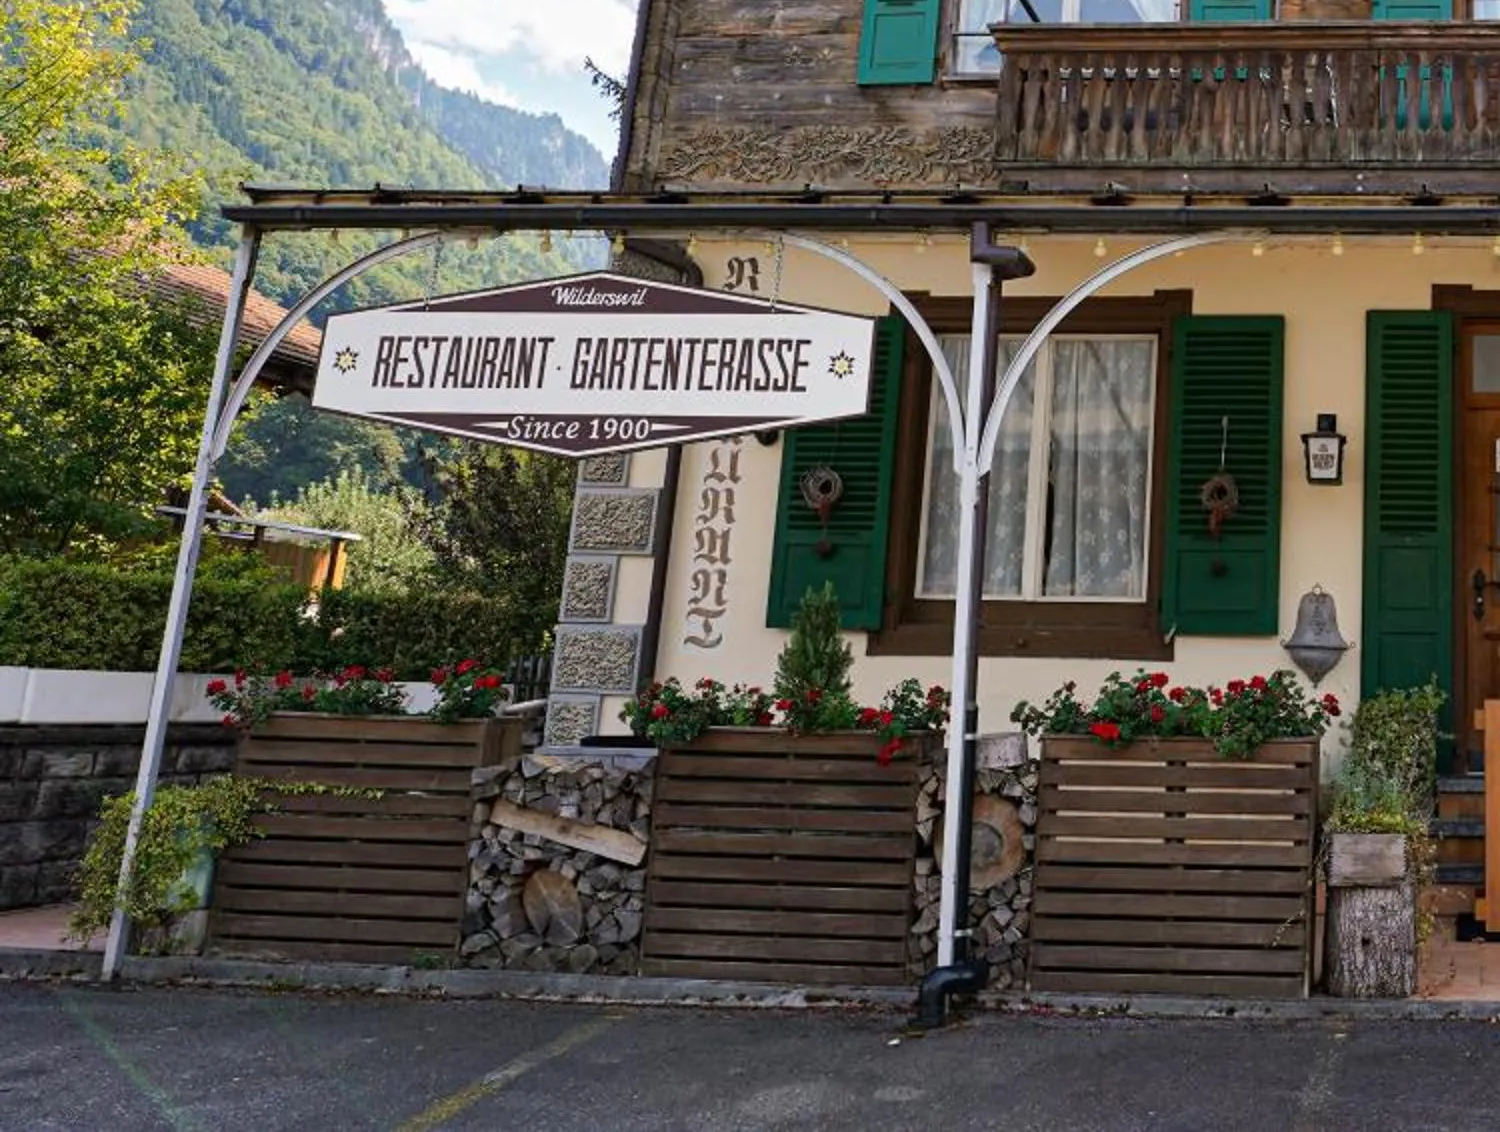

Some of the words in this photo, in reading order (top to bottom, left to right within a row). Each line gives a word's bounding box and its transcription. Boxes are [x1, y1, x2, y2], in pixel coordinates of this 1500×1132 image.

[550, 286, 647, 307] Wilderswil
[371, 336, 556, 389] RESTAURANT
[569, 337, 812, 392] GARTENTERASSE
[506, 415, 579, 439] Since
[588, 417, 650, 439] 1900
